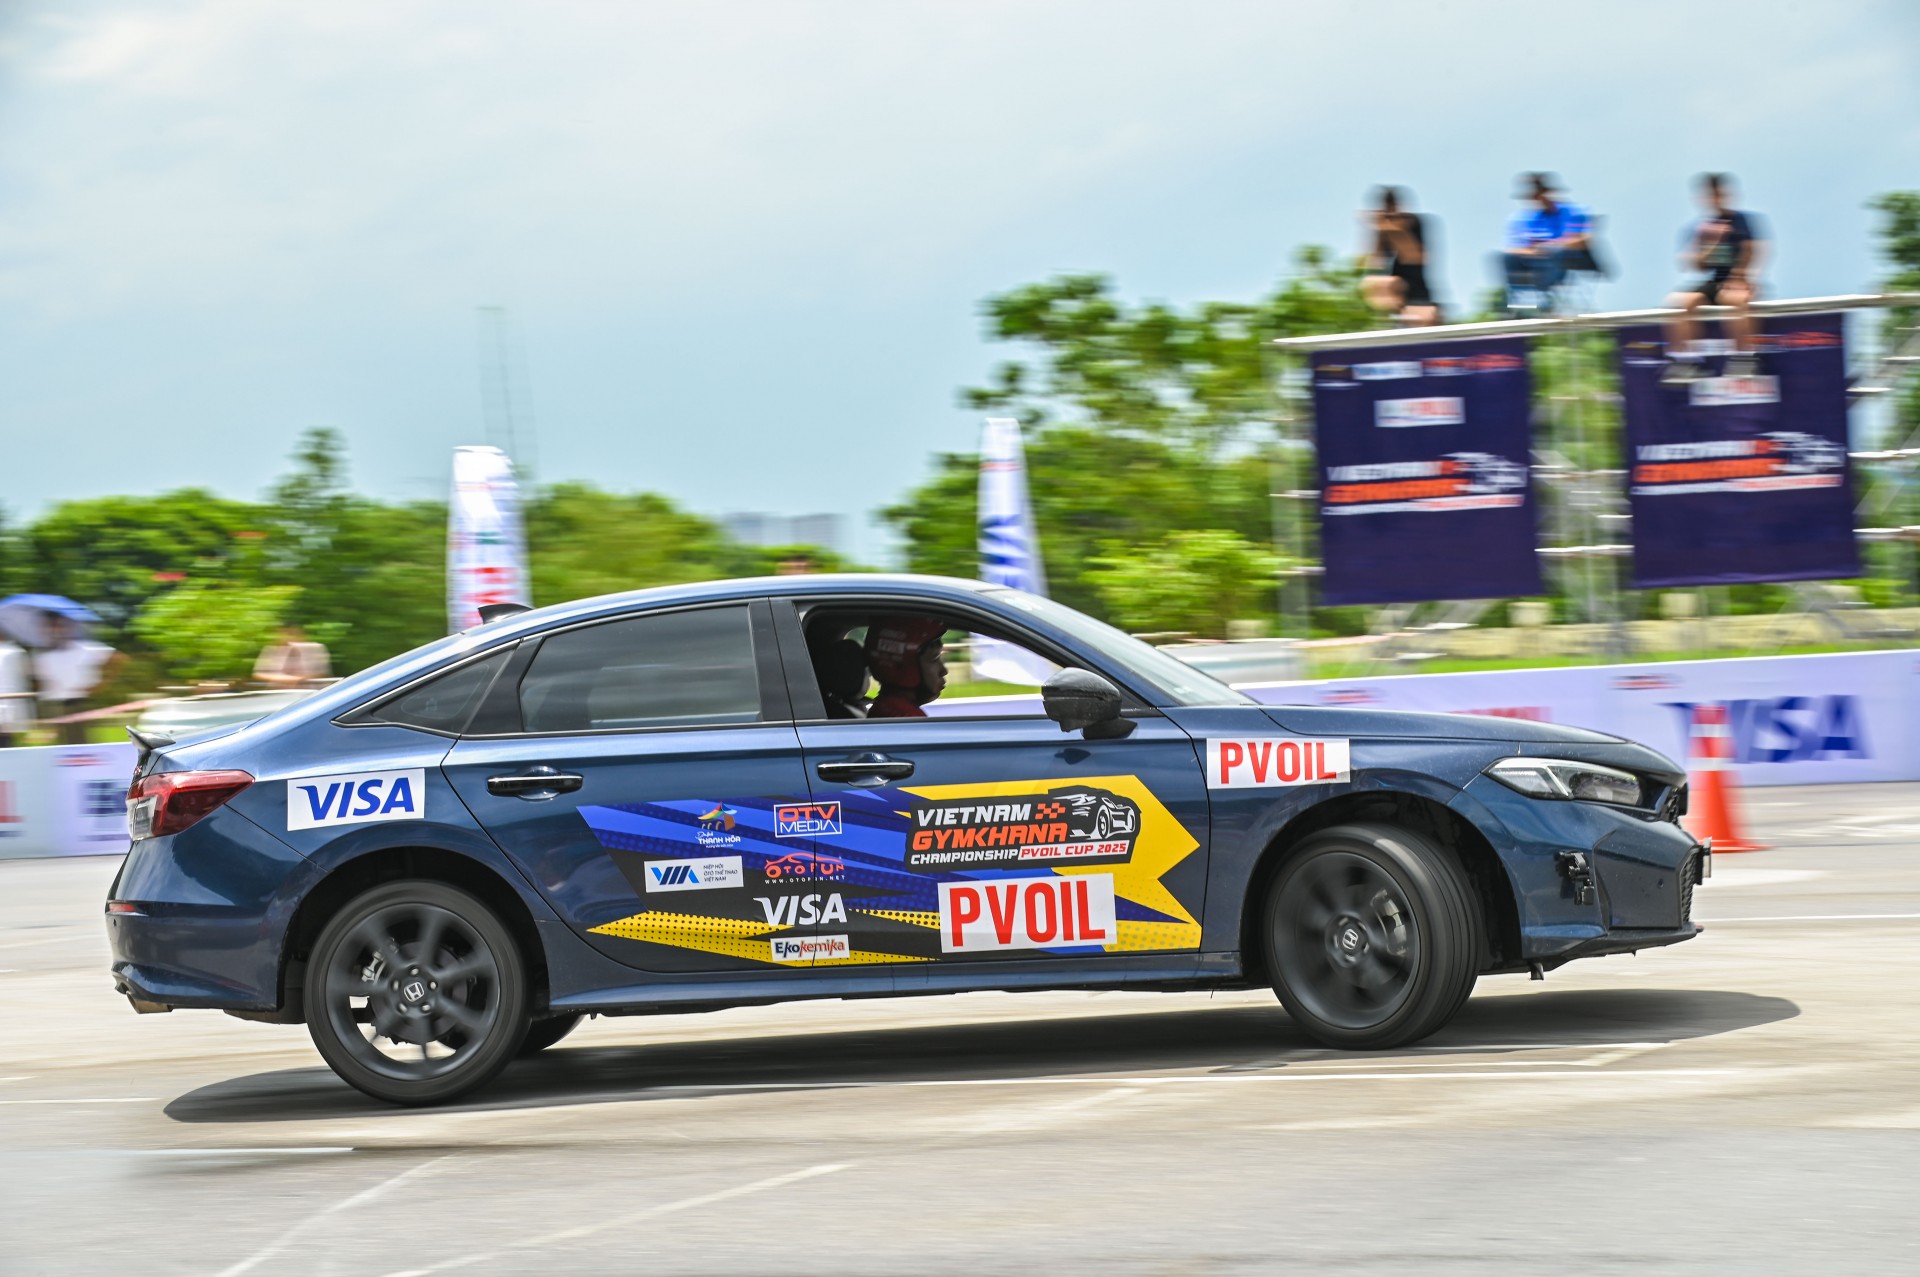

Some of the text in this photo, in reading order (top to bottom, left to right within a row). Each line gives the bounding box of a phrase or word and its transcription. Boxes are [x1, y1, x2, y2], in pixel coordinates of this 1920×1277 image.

[1220, 742, 1337, 784] PVOIL
[296, 777, 415, 821] VISA
[779, 805, 837, 822] OTV
[917, 803, 1031, 827] VIETNAM
[780, 819, 839, 834] MEDIA
[912, 823, 1068, 850] GYMKHANA
[910, 843, 1126, 865] CHAMPIONSHIP PVOIL CUP 2025
[766, 862, 845, 879] OTOFUN
[752, 892, 848, 927] VISA
[949, 880, 1106, 948] PVOIL
[775, 939, 846, 959] Ekokemika
